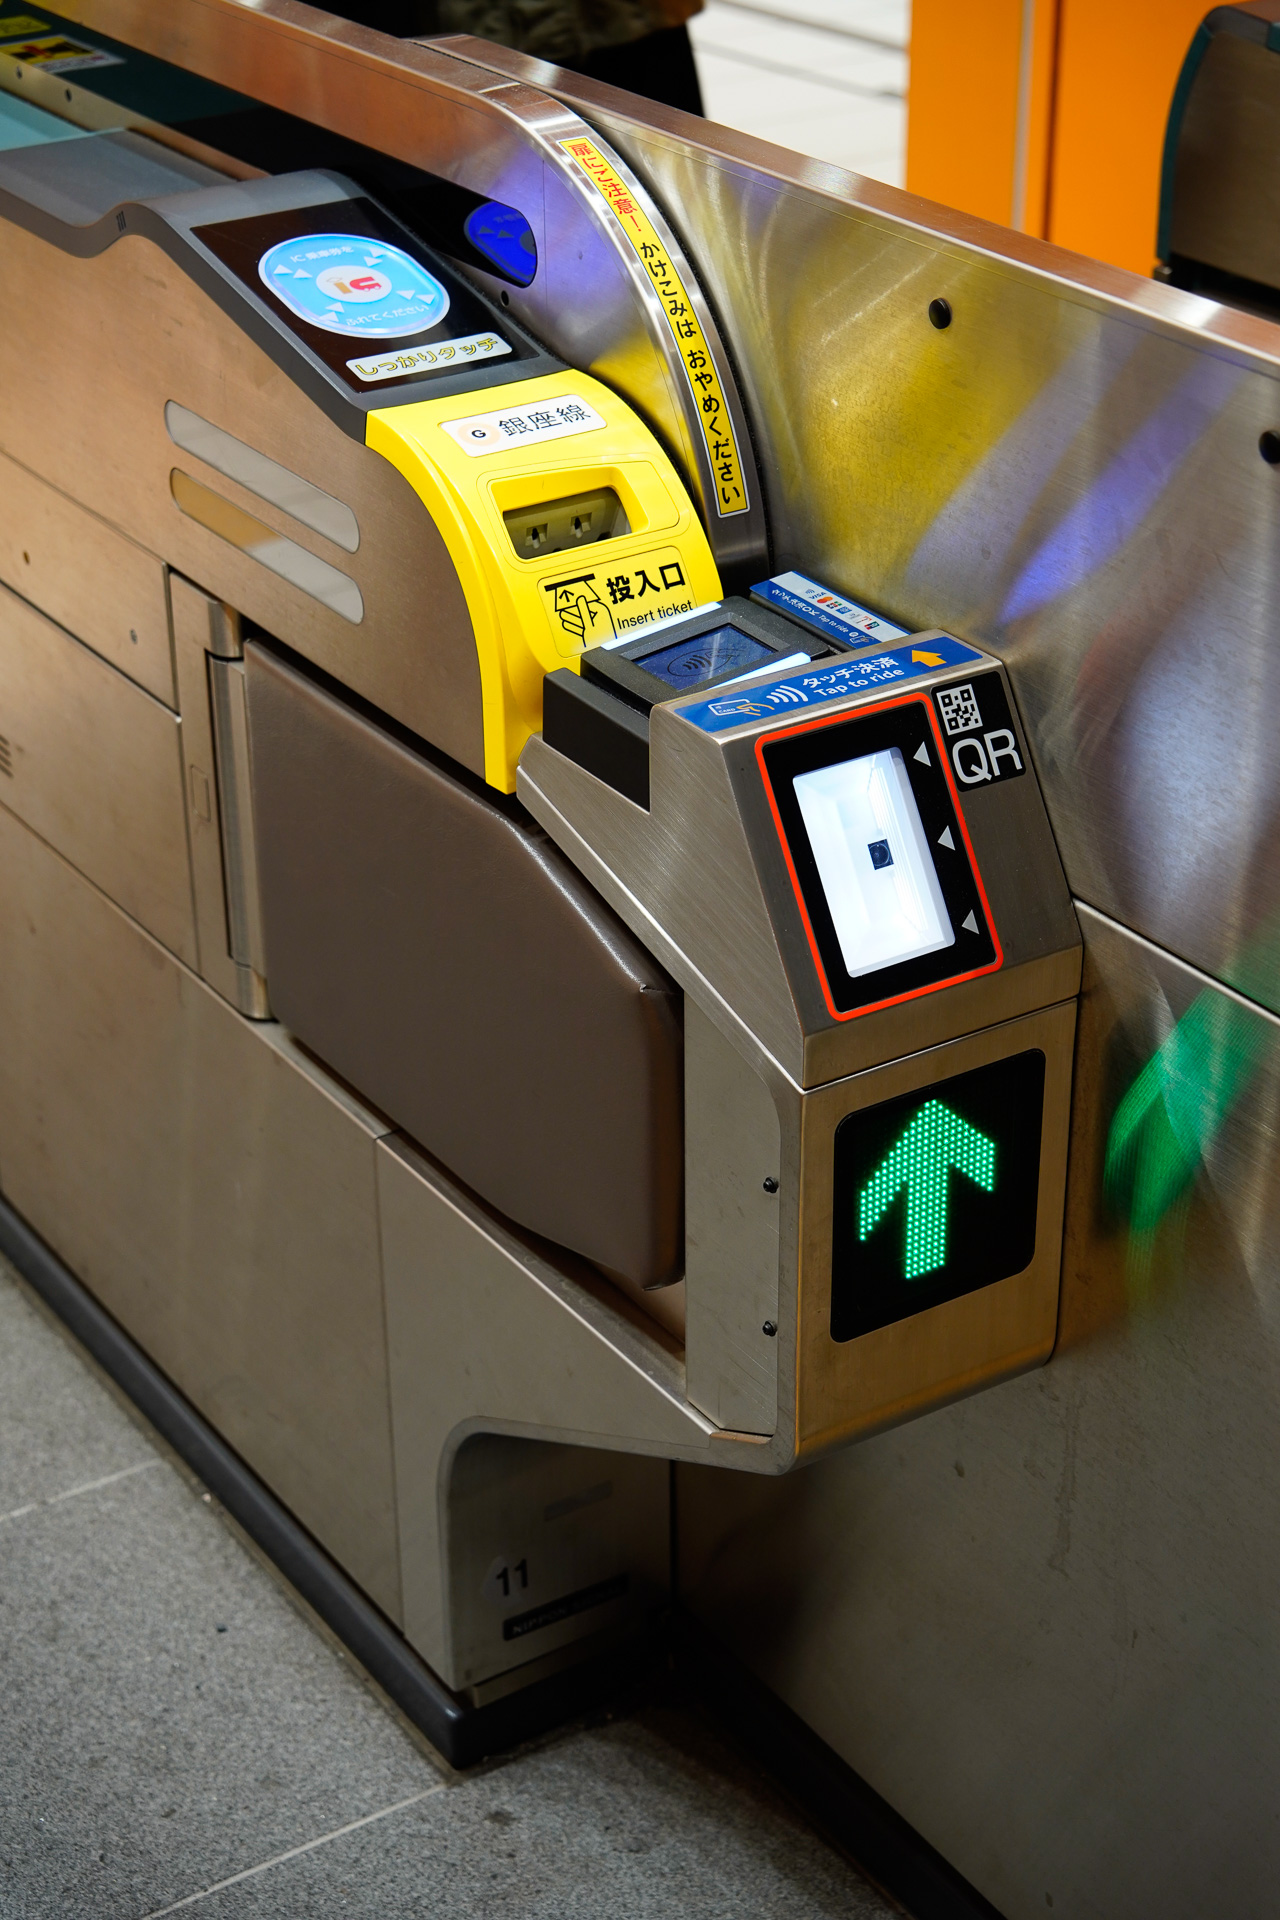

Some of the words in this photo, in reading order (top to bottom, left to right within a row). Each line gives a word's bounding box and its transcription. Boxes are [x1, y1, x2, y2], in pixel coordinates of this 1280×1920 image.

[345, 304, 430, 327] ふれてください
[355, 337, 499, 377] しっかりタッチ
[640, 242, 697, 340] かけこみは
[687, 349, 741, 505] おやめください
[471, 429, 487, 439] G
[498, 404, 592, 437] 銀座線
[606, 562, 686, 605] 投入口
[809, 591, 827, 600] VISA
[616, 609, 655, 630] Insert
[657, 599, 694, 620] ticket
[802, 656, 900, 689] タッチ決済
[813, 683, 849, 698] Tap
[848, 678, 869, 689] to
[871, 666, 905, 684] ride
[952, 728, 1023, 784] QR
[496, 1558, 528, 1596] 11
